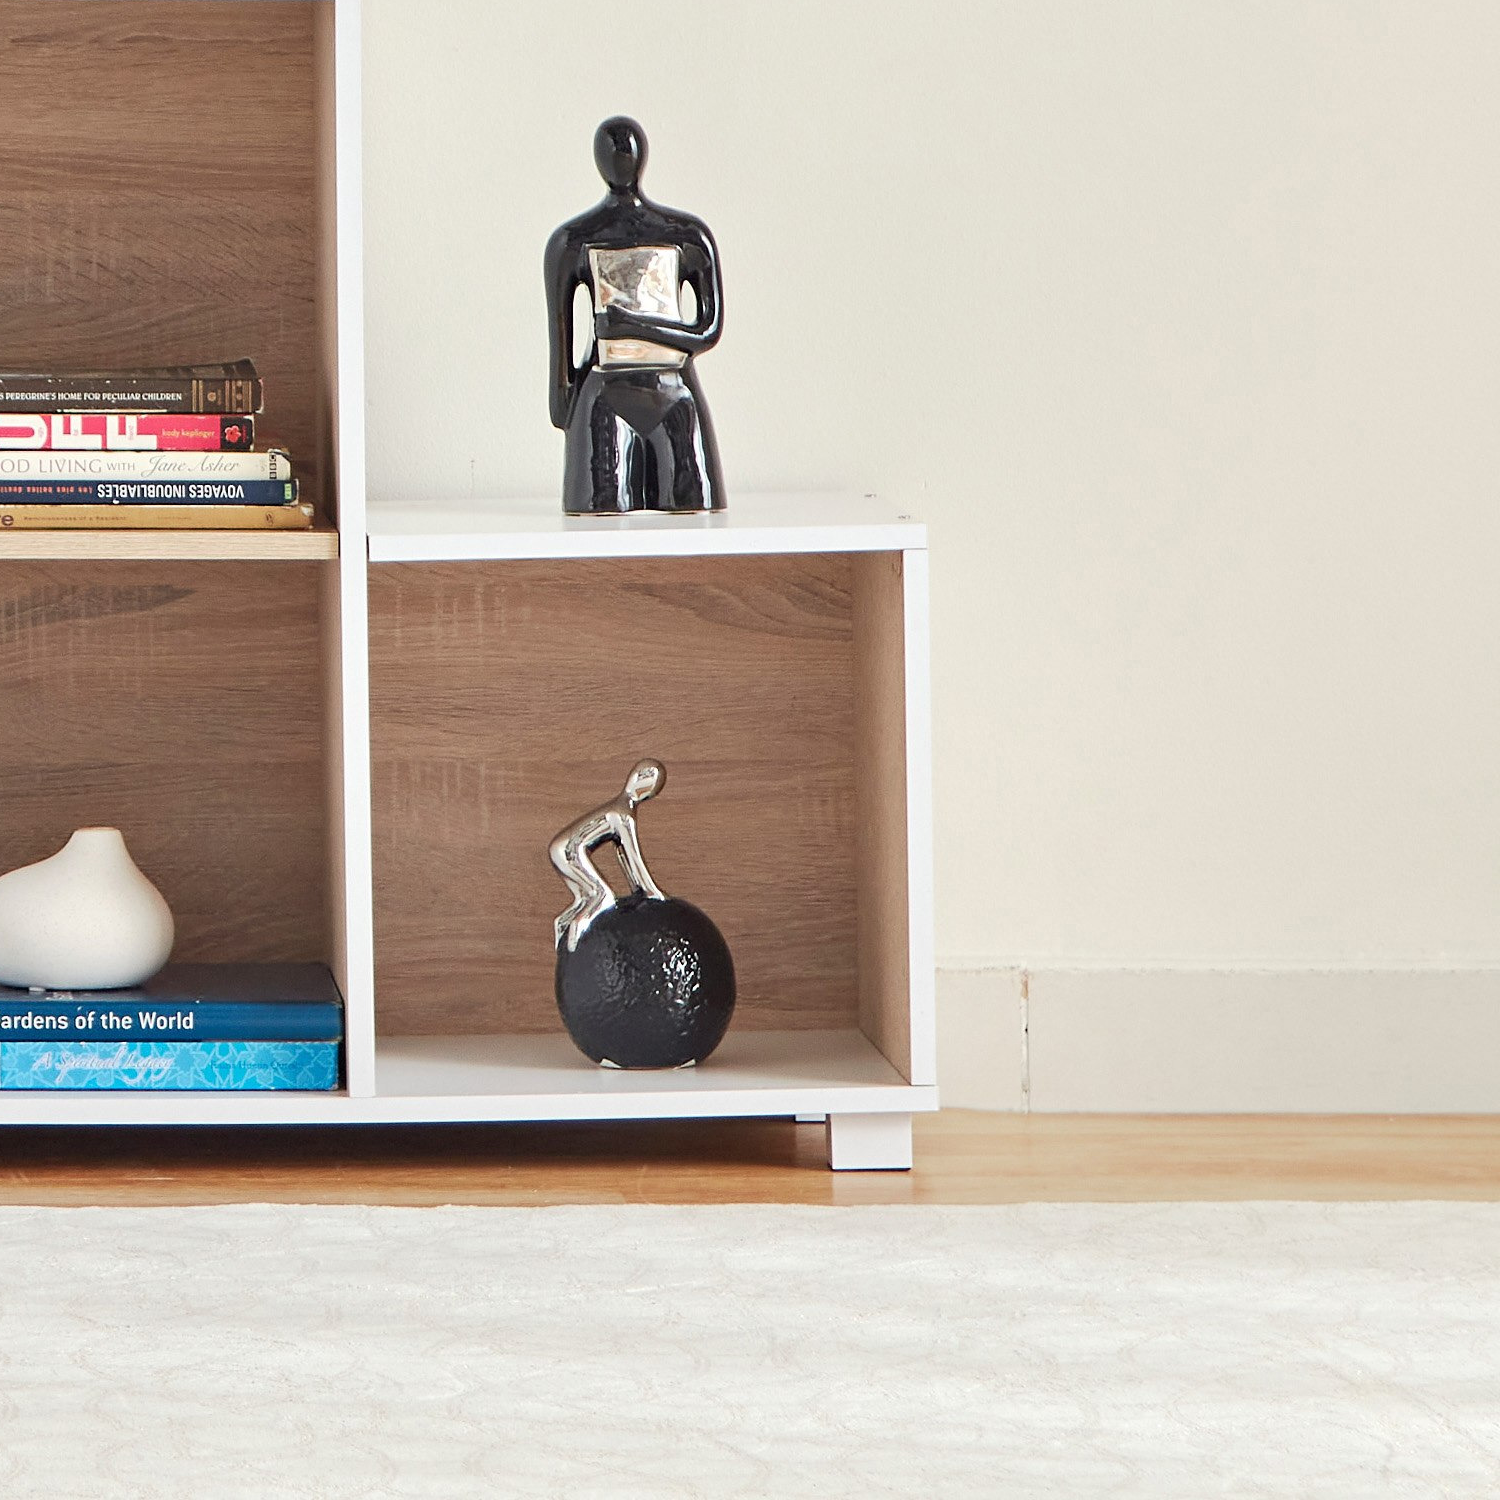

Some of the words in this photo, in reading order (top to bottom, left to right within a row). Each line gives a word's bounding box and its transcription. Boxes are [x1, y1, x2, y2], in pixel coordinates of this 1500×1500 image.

[5, 392, 57, 401] PEREGRINE'S
[58, 392, 82, 401] HOME
[84, 392, 101, 401] FOR
[102, 392, 141, 401] PECULIAR
[142, 392, 183, 401] CHILDREN
[39, 458, 103, 474] LIVING
[106, 462, 136, 472] WITH
[140, 455, 187, 478] Jane
[187, 455, 240, 473] Asher
[97, 483, 186, 498] INOUBLIABLES
[188, 484, 245, 499] VOYAGES
[74, 1010, 96, 1030] of
[99, 1011, 133, 1030] the
[138, 1011, 194, 1030] World
